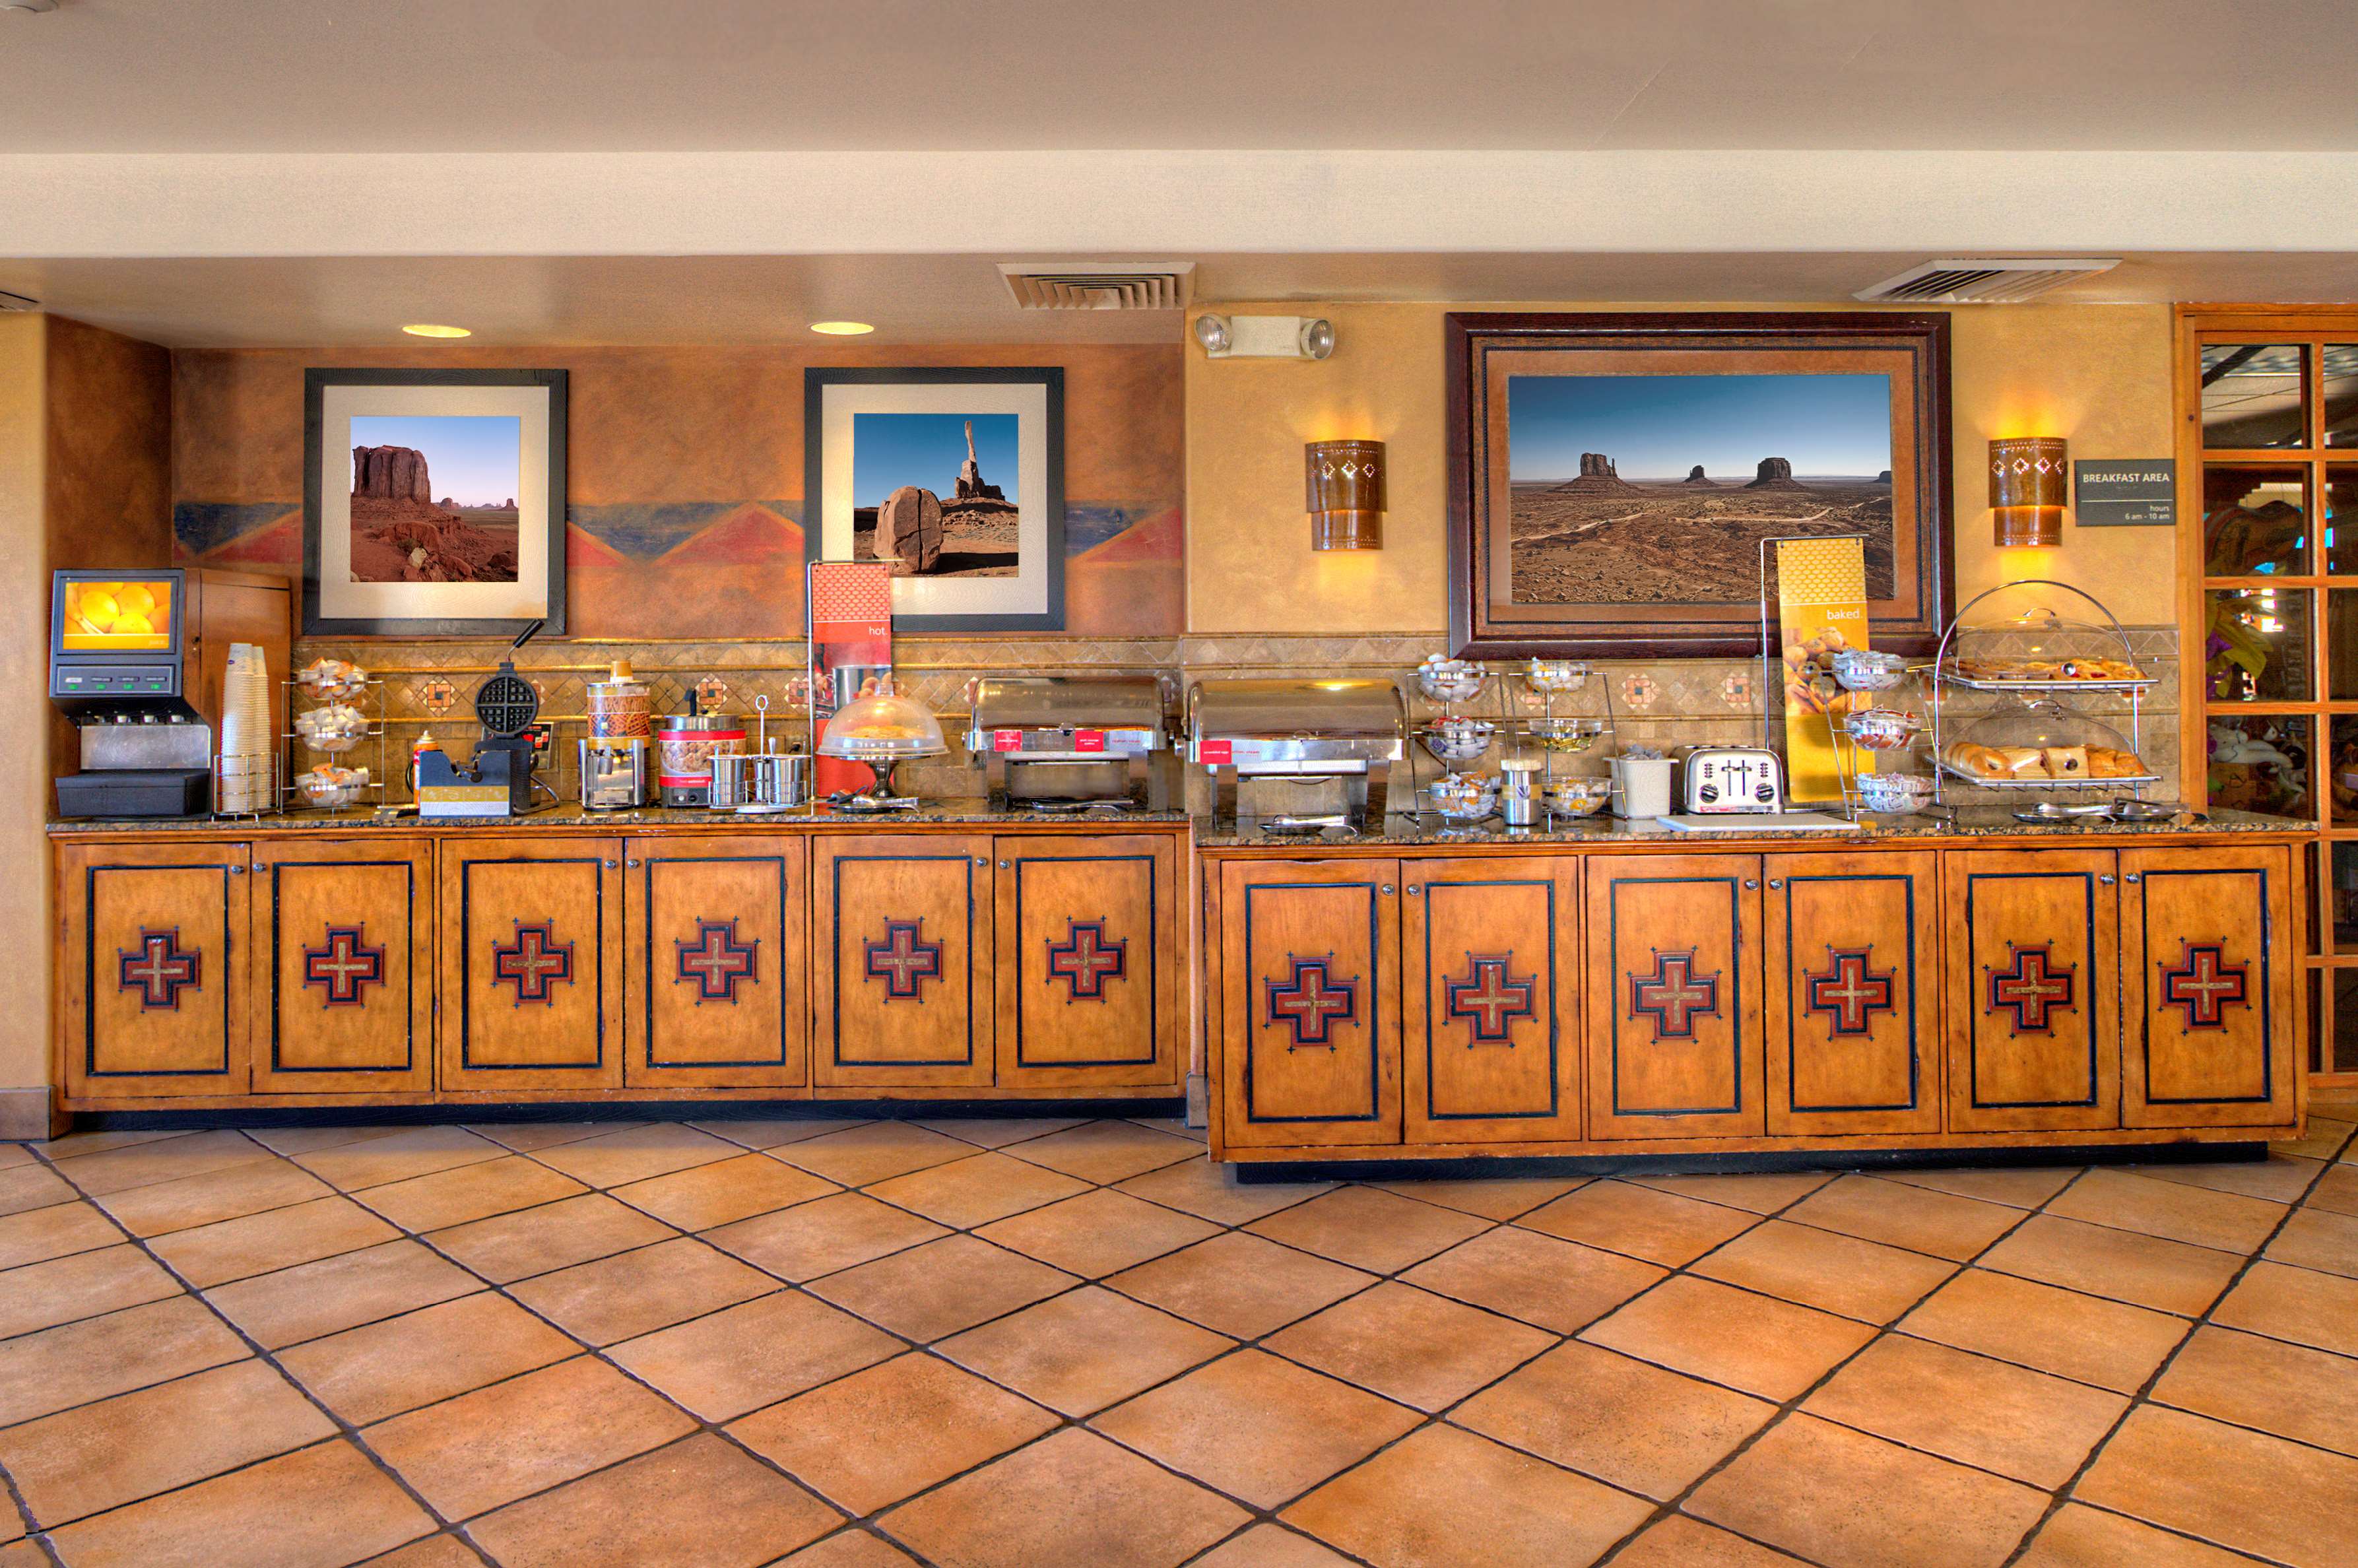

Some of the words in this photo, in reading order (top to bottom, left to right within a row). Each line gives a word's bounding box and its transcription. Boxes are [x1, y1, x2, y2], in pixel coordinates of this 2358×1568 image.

[2083, 473, 2140, 483] BREAKFAST
[2142, 473, 2170, 482] AREA
[1827, 608, 1863, 620] baked.
[868, 626, 888, 636] hot.
